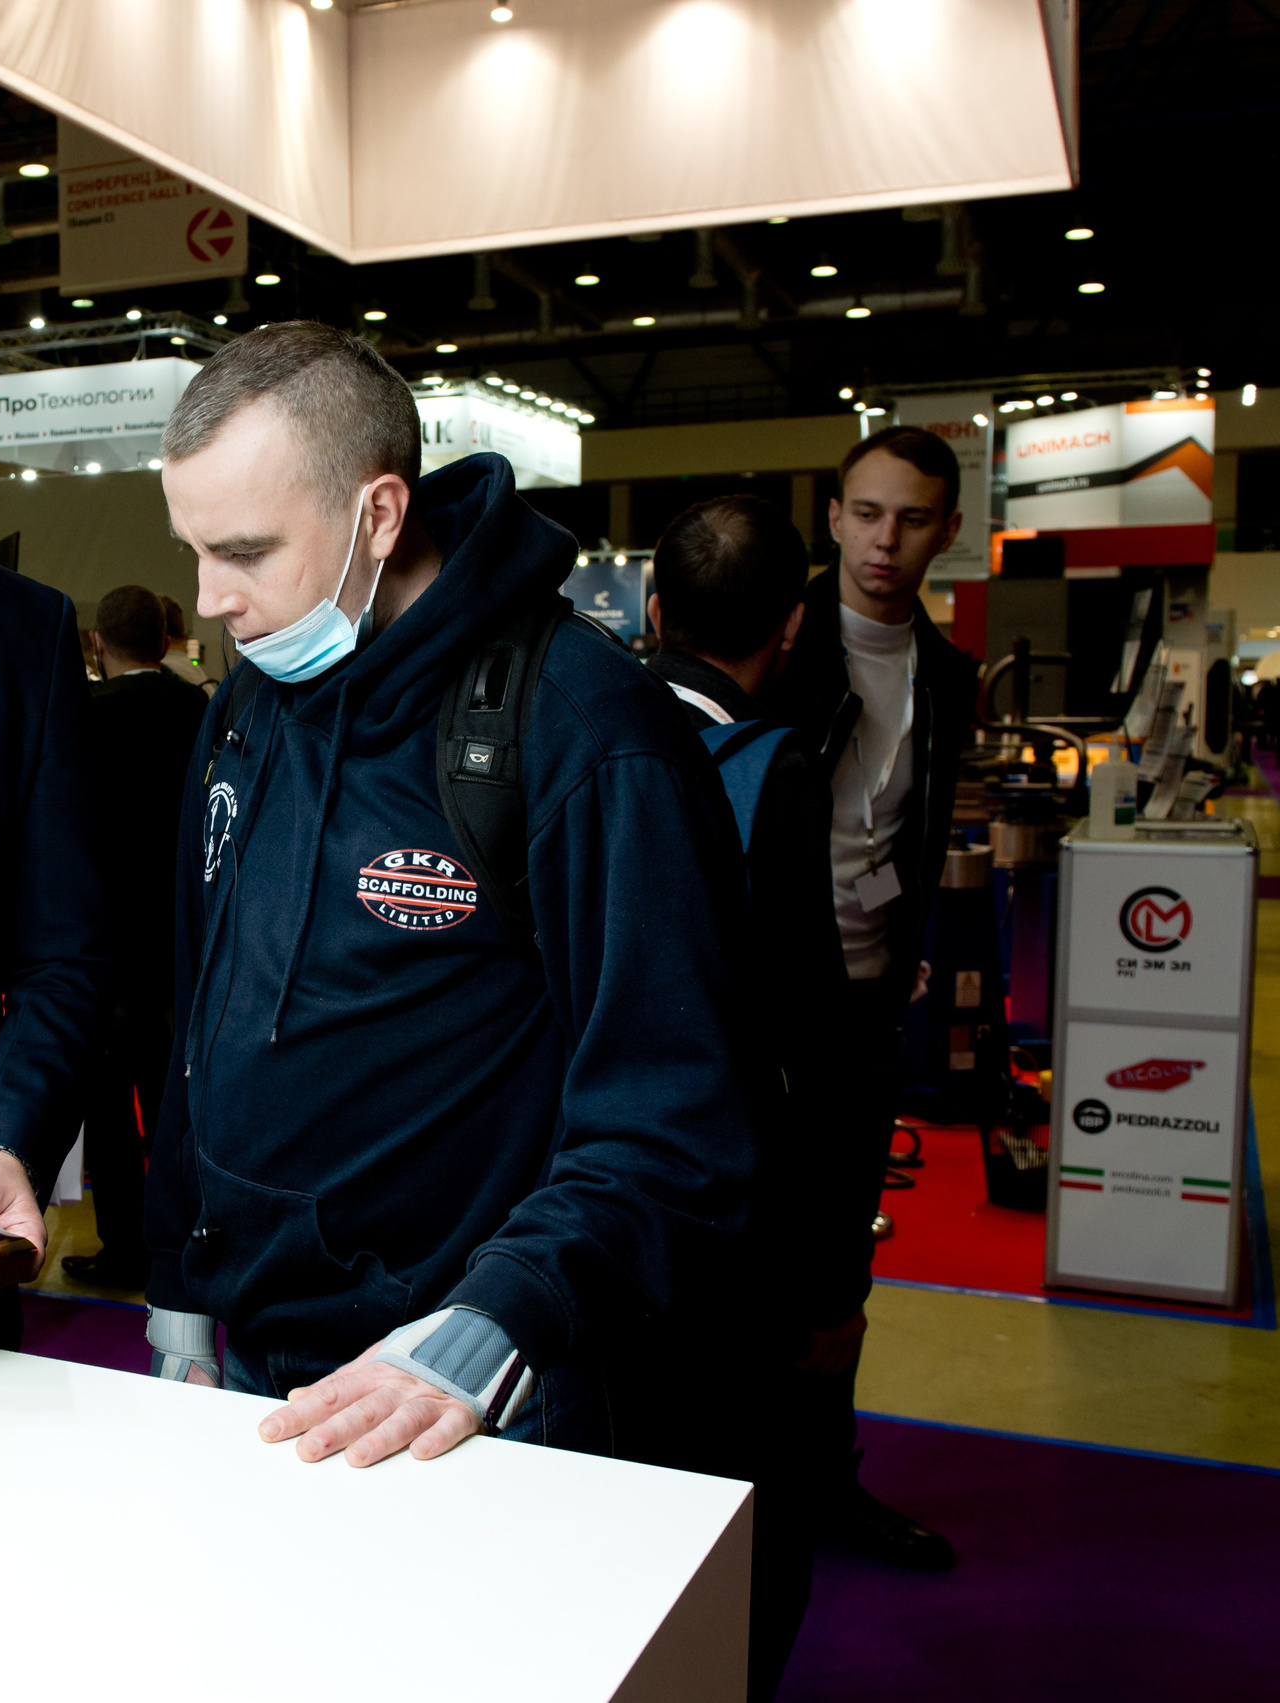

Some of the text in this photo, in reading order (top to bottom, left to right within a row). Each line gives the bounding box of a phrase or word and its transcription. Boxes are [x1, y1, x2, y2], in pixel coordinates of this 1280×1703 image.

[67, 192, 145, 212] CONFERENCE
[148, 187, 179, 200] HALL
[1017, 430, 1110, 458] UNIMACH
[384, 852, 456, 878] GKR
[357, 877, 477, 903] SCAFFOLDING
[378, 903, 454, 926] LIMITED
[1117, 957, 1191, 972] СИ ЭМ ЭЛ
[1116, 1113, 1220, 1134] PEDRAZZOLI
